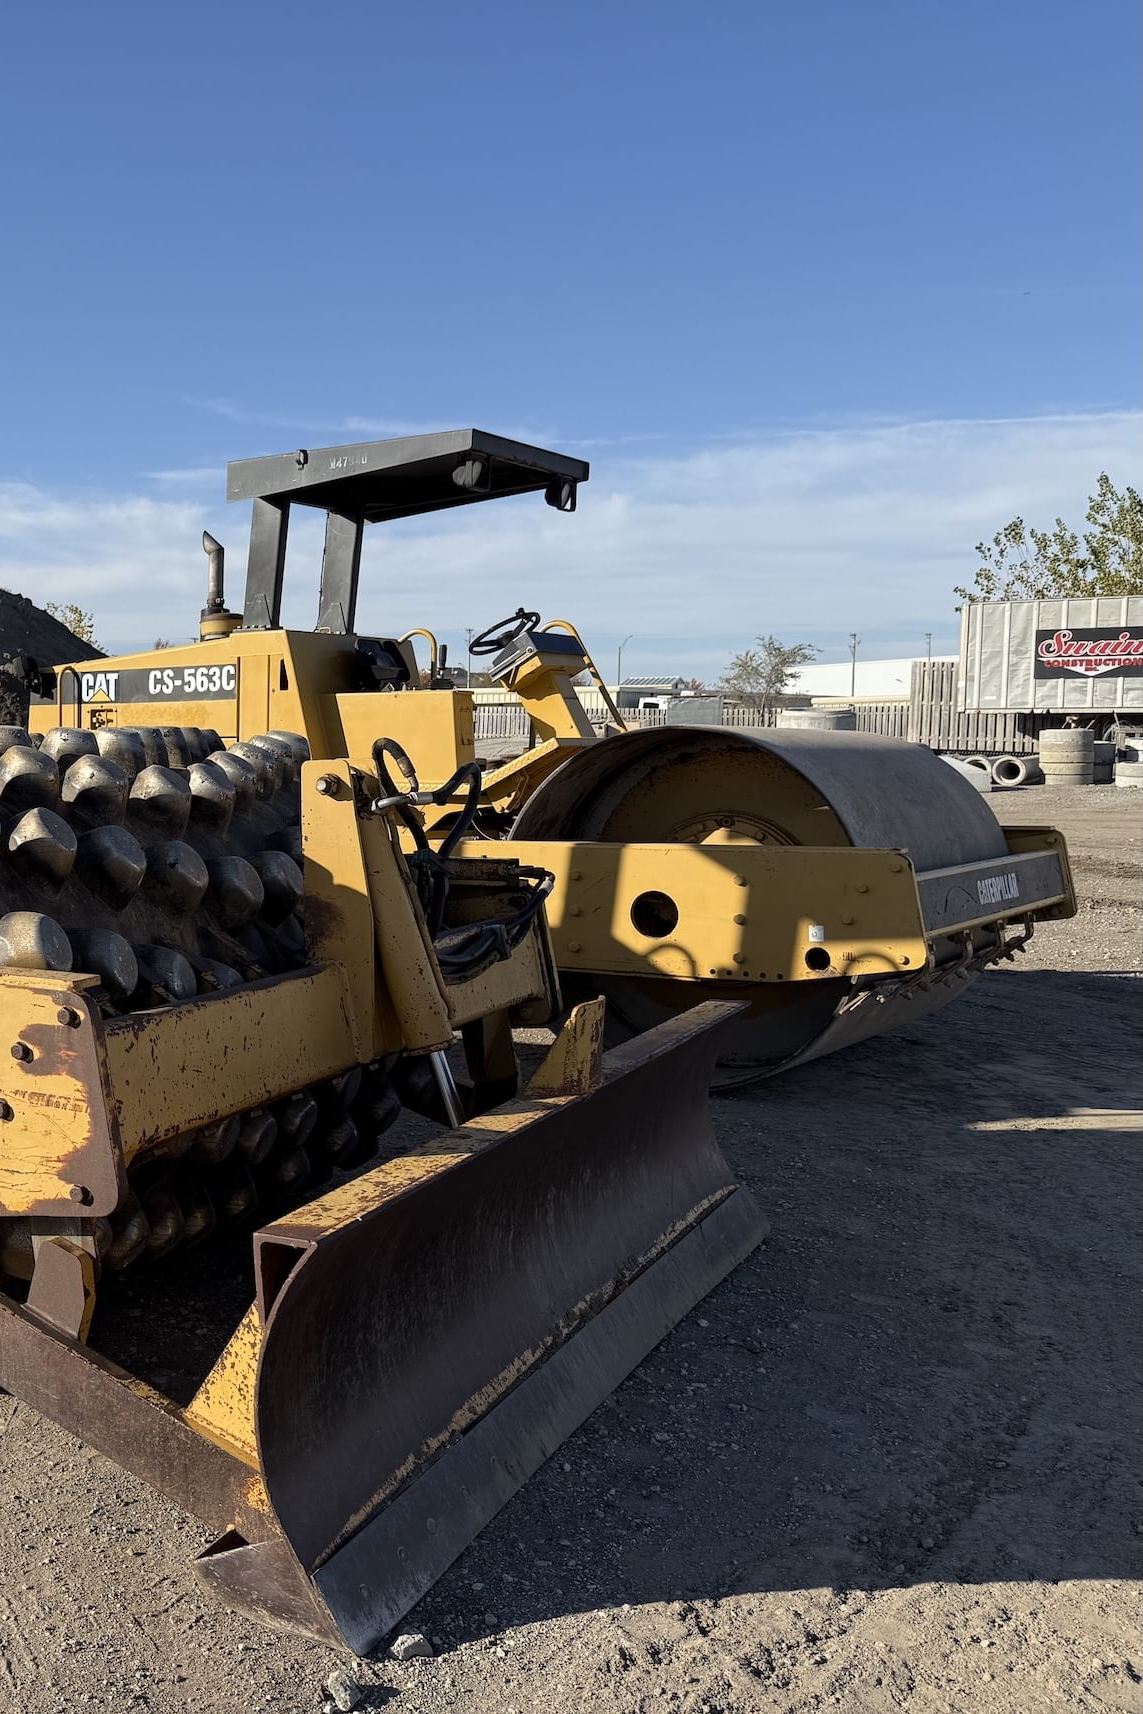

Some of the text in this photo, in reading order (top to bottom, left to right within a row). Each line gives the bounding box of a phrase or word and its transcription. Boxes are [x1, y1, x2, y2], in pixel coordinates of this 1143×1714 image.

[1038, 629, 1143, 657] Swain
[1044, 657, 1143, 668] CONSTRUCTION
[81, 665, 236, 702] CAT CS-563C
[977, 872, 1019, 905] CATERPILLAR
